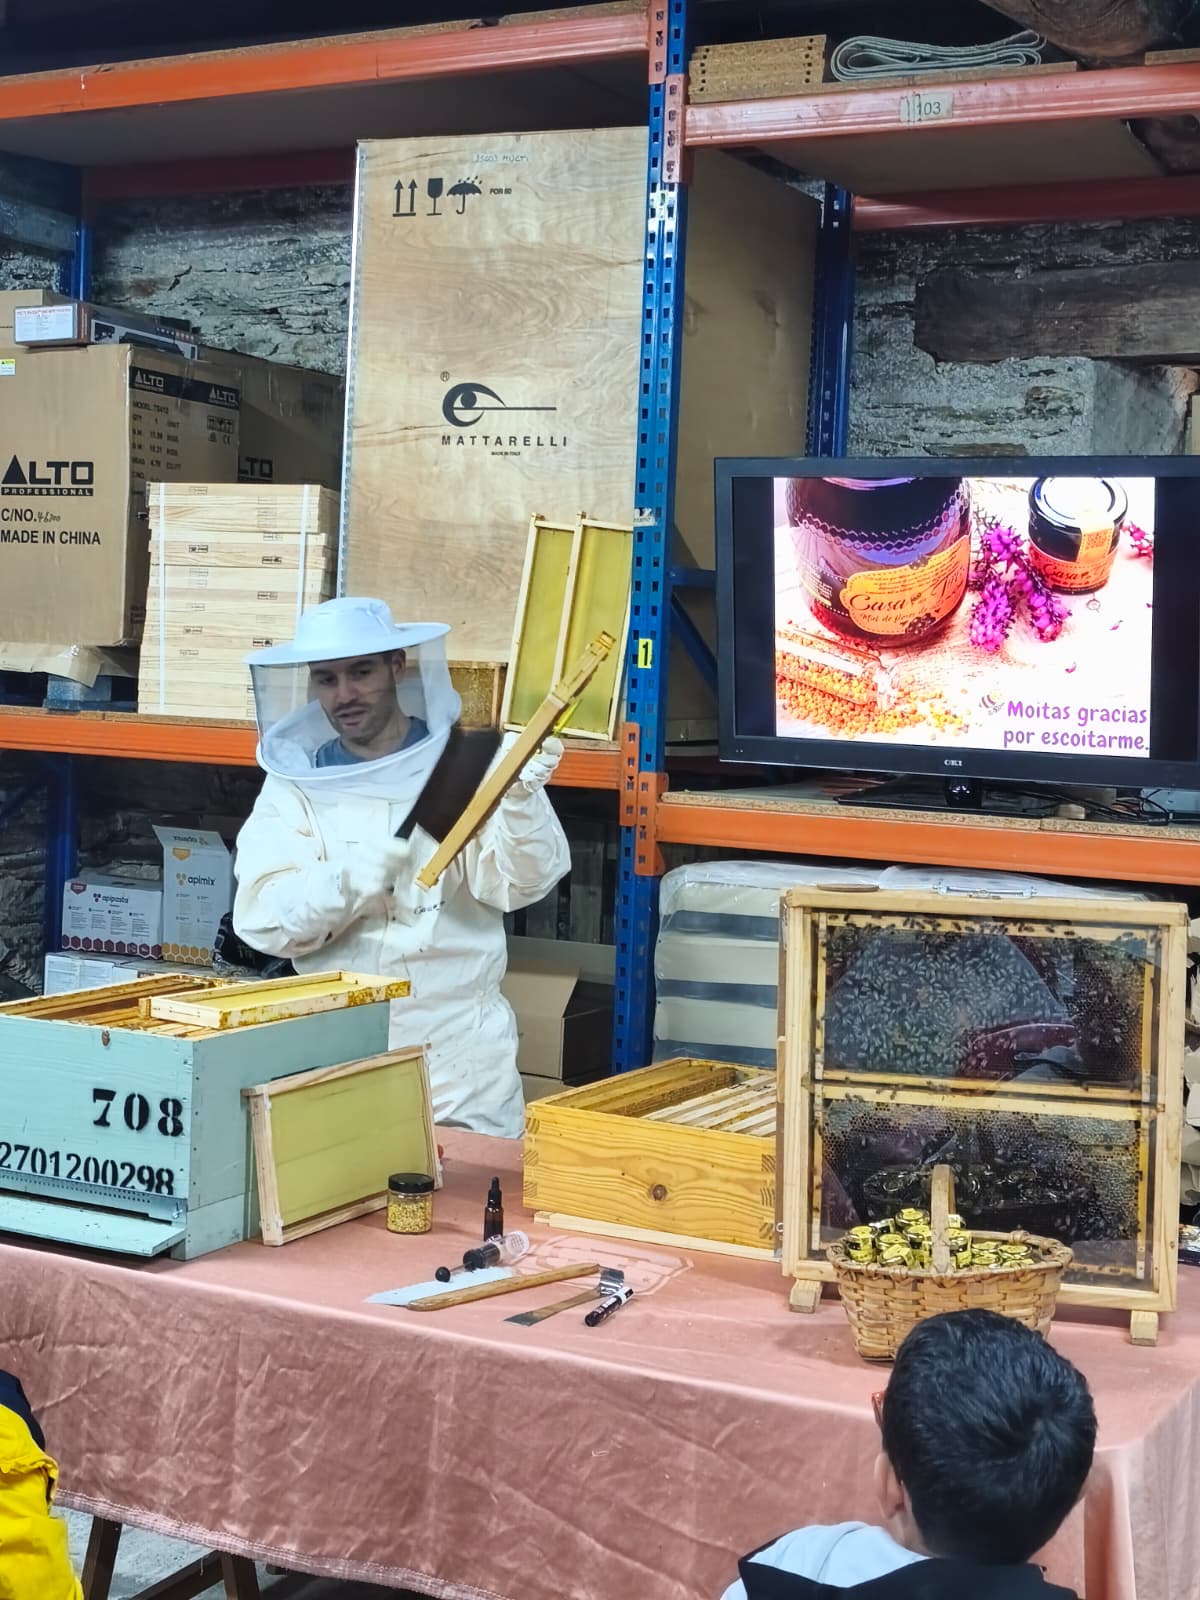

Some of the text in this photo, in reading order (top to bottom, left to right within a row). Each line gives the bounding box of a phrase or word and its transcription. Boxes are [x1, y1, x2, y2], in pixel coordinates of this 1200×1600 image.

[135, 369, 164, 388] ALTO
[209, 385, 236, 403] ALTO
[441, 434, 567, 447] MATTARELLI
[1, 454, 94, 485] ALTO
[4, 488, 91, 496] PROFESSIONAL
[1, 507, 37, 522] C/NO.
[1, 530, 101, 545] MADE IN CHINA
[849, 593, 906, 611] Casa
[641, 642, 649, 665] 1
[1007, 700, 1148, 727] Moitas gracias
[1003, 729, 1150, 751] por escoitarme.
[187, 875, 216, 887] apimix
[92, 1087, 185, 1138] 708
[0, 1141, 175, 1196] 2701200298
